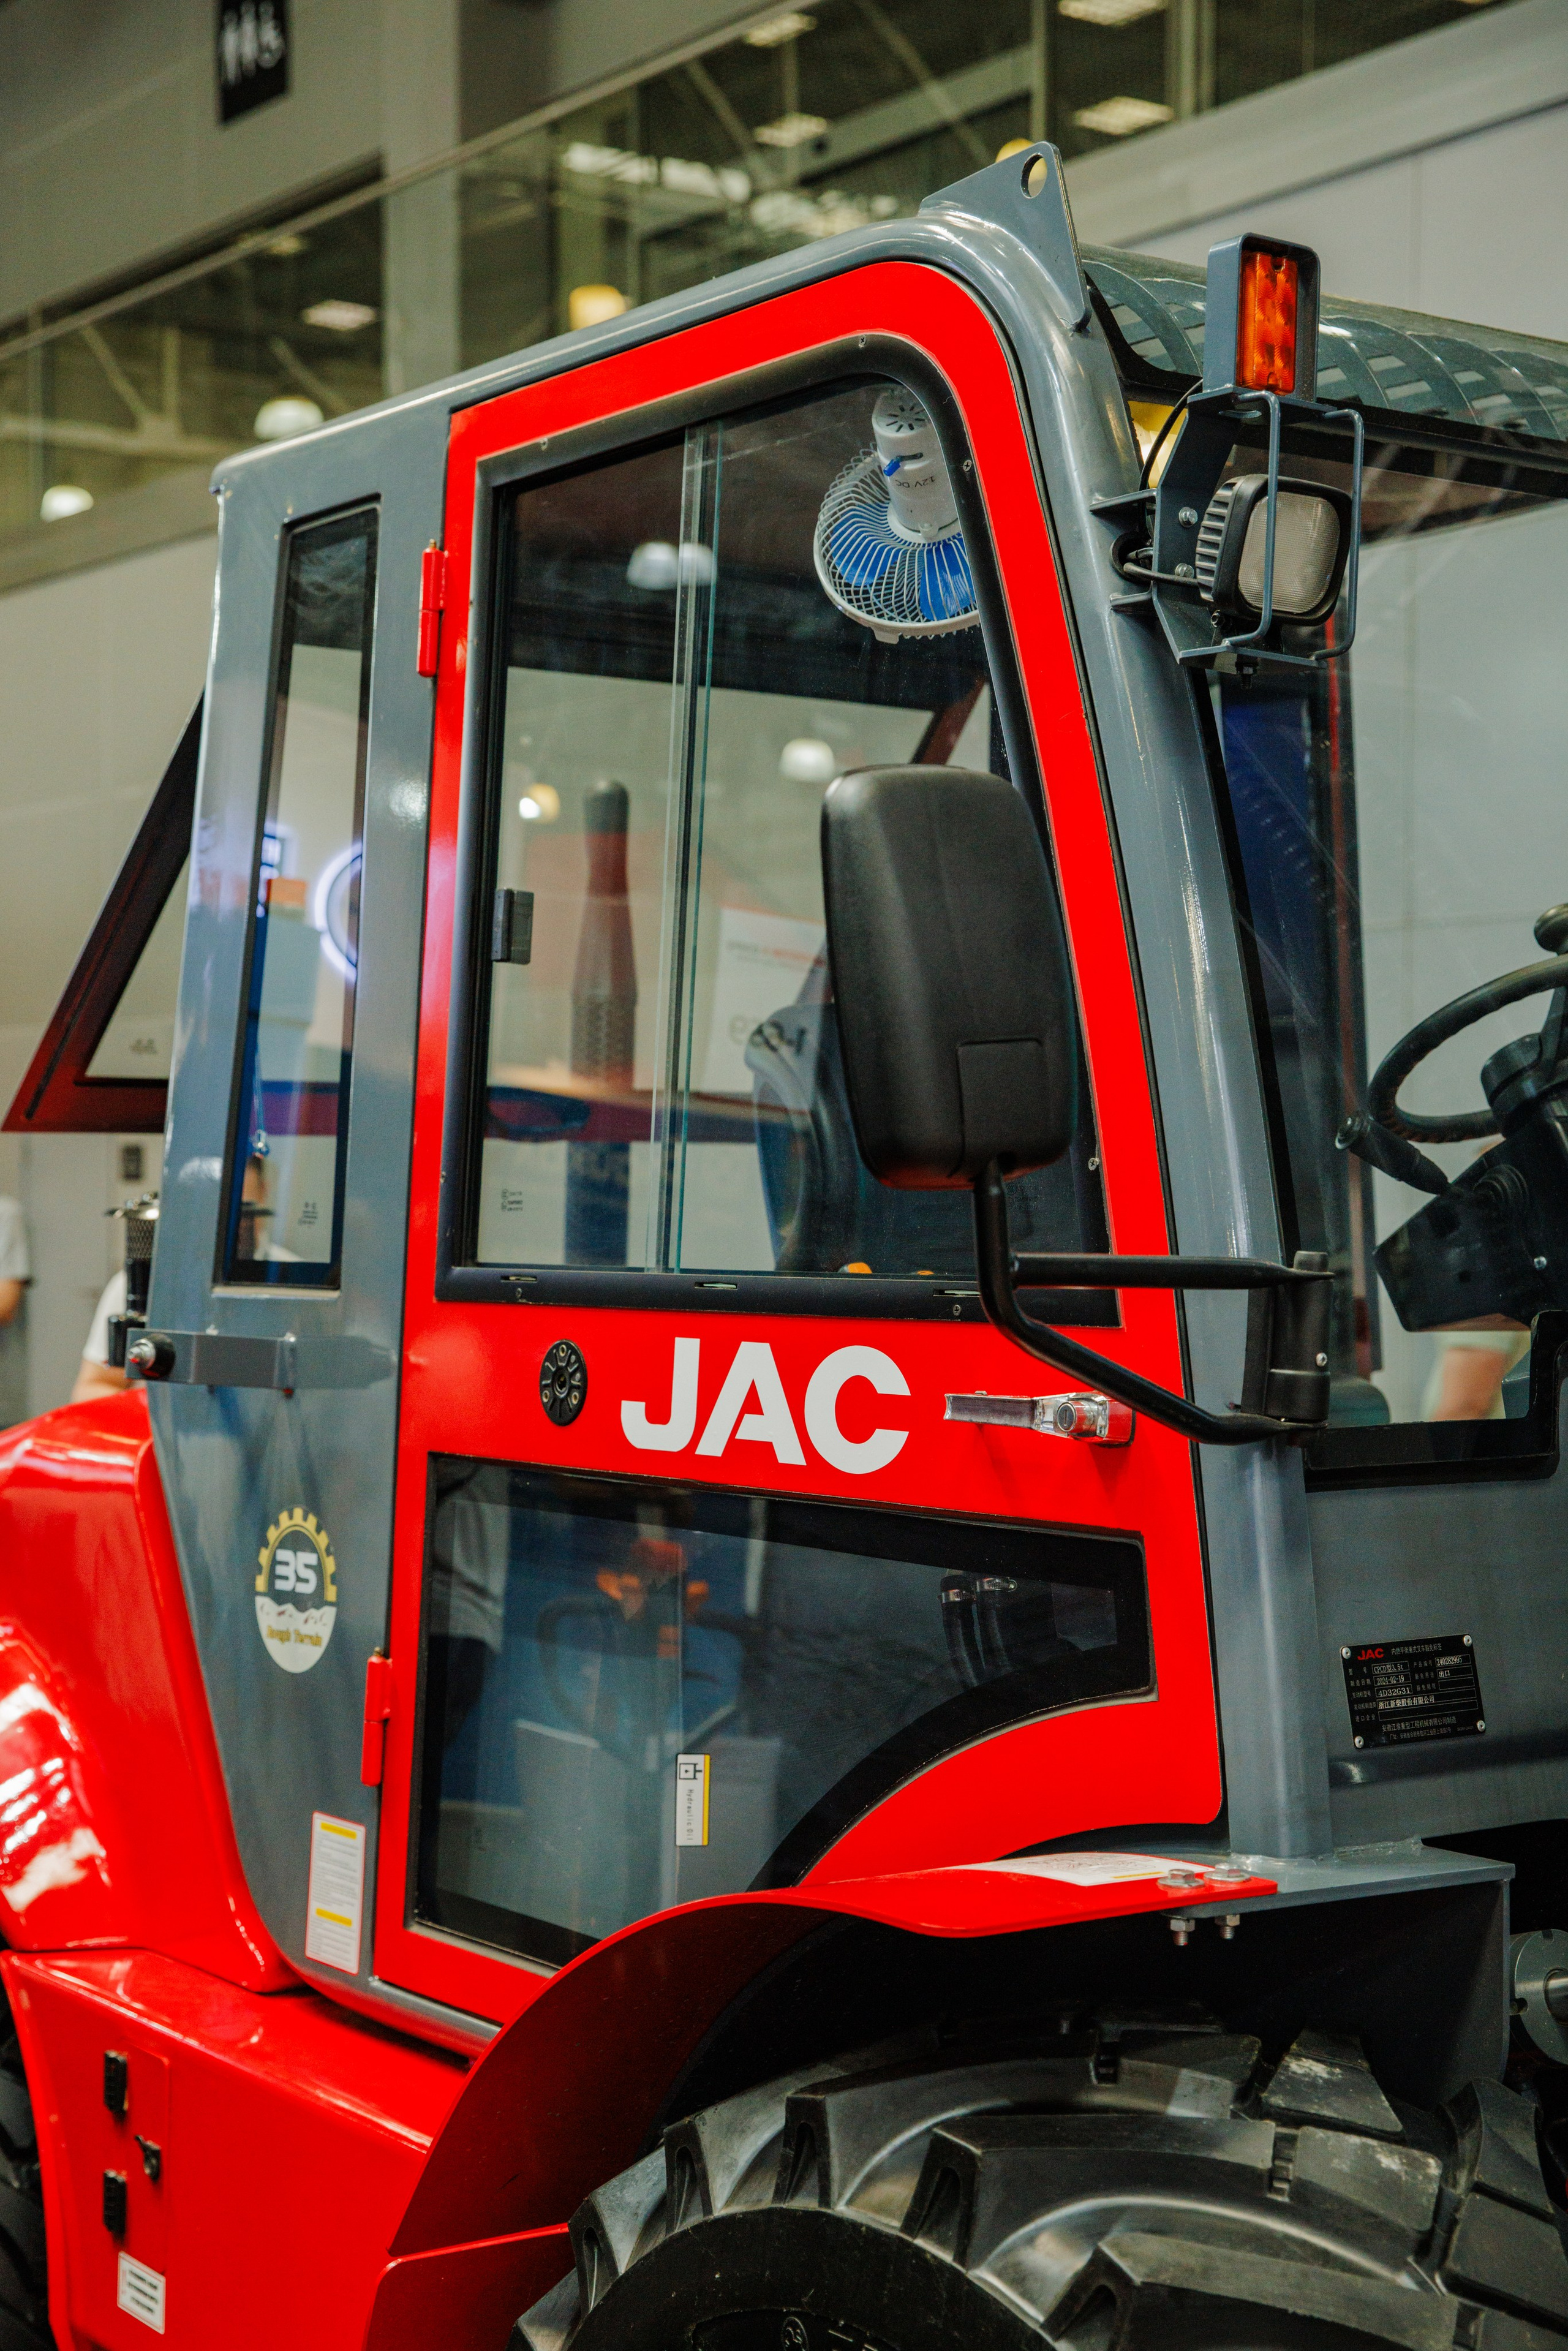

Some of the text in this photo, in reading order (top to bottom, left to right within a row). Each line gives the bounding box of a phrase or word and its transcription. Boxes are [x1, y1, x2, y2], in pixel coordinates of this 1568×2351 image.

[914, 477, 935, 488] 12V
[620, 1337, 911, 1475] JAC
[274, 1549, 318, 1594] 35
[294, 1629, 322, 1647] Terrain
[1357, 1648, 1384, 1660] JAC
[1376, 1675, 1404, 1685] 2024-02-19
[1378, 1687, 1410, 1697] 4D32G31
